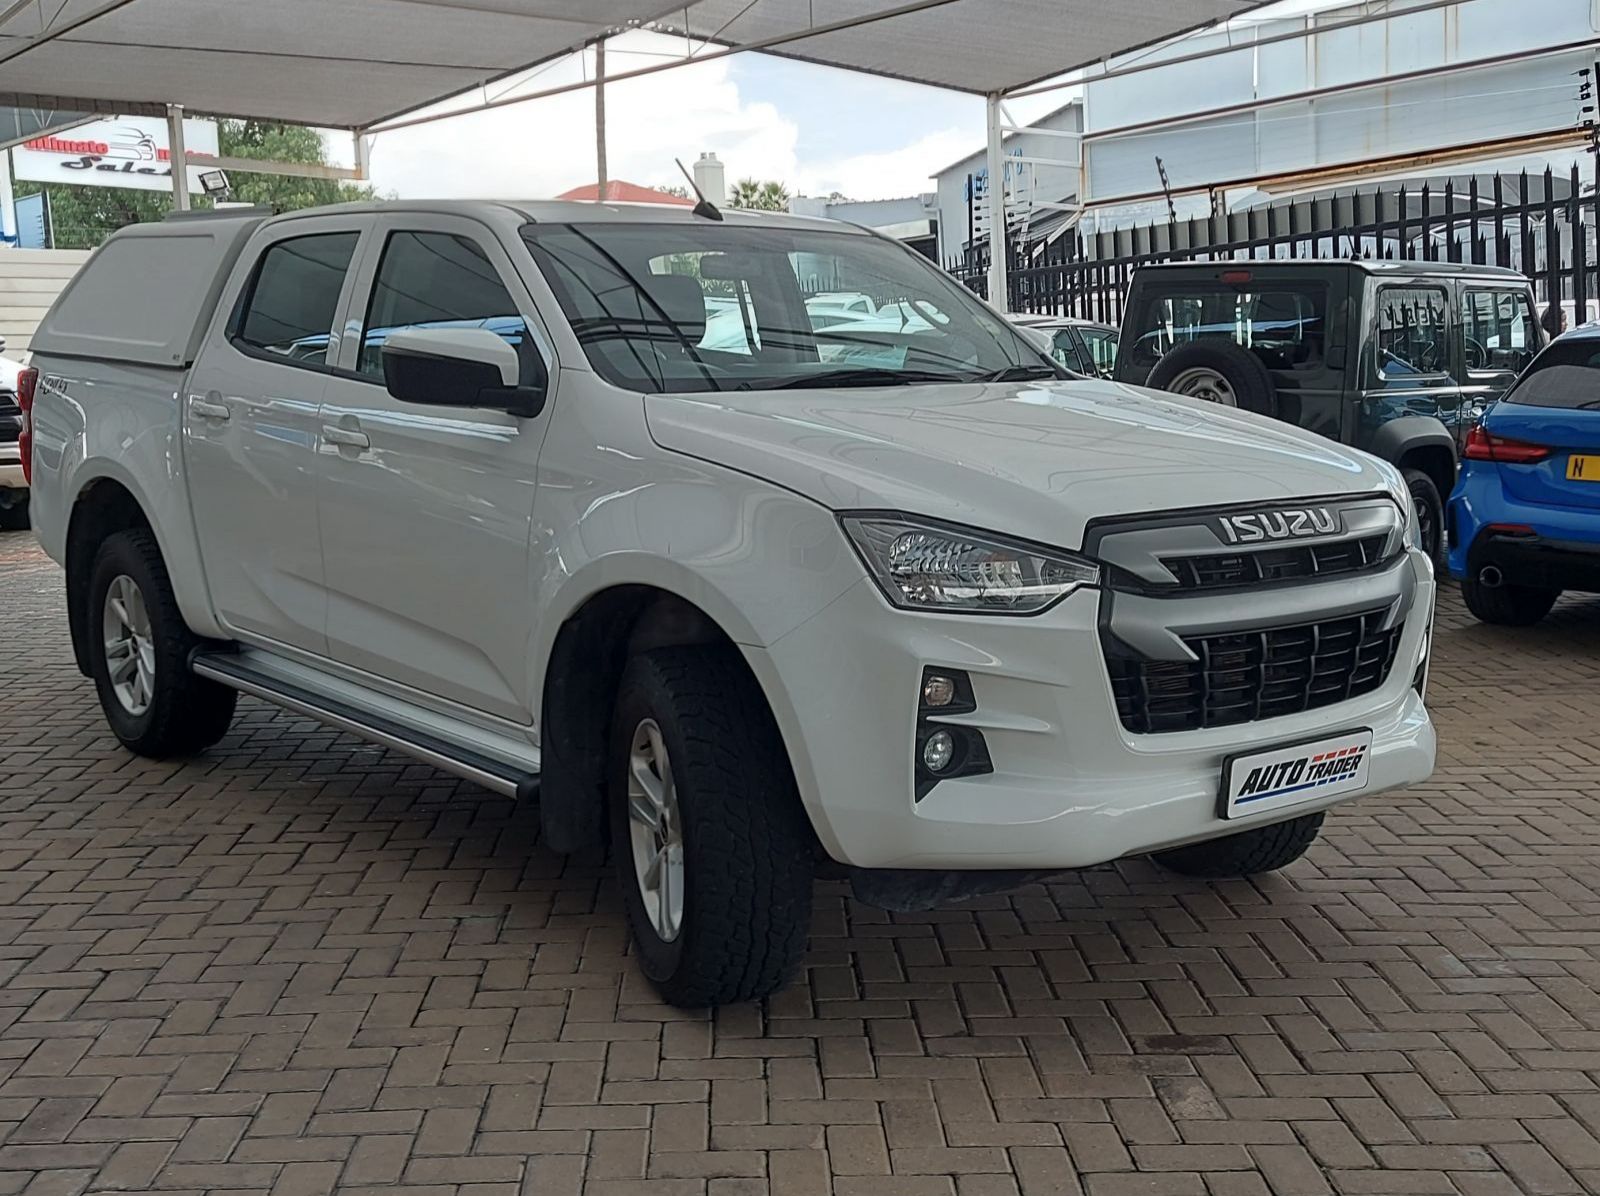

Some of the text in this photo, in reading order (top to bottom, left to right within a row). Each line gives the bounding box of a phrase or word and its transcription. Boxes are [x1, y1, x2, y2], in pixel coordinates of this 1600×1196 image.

[1572, 457, 1585, 478] N
[1218, 507, 1335, 543] ISUZU
[1237, 754, 1364, 797] AUTO TRADER
